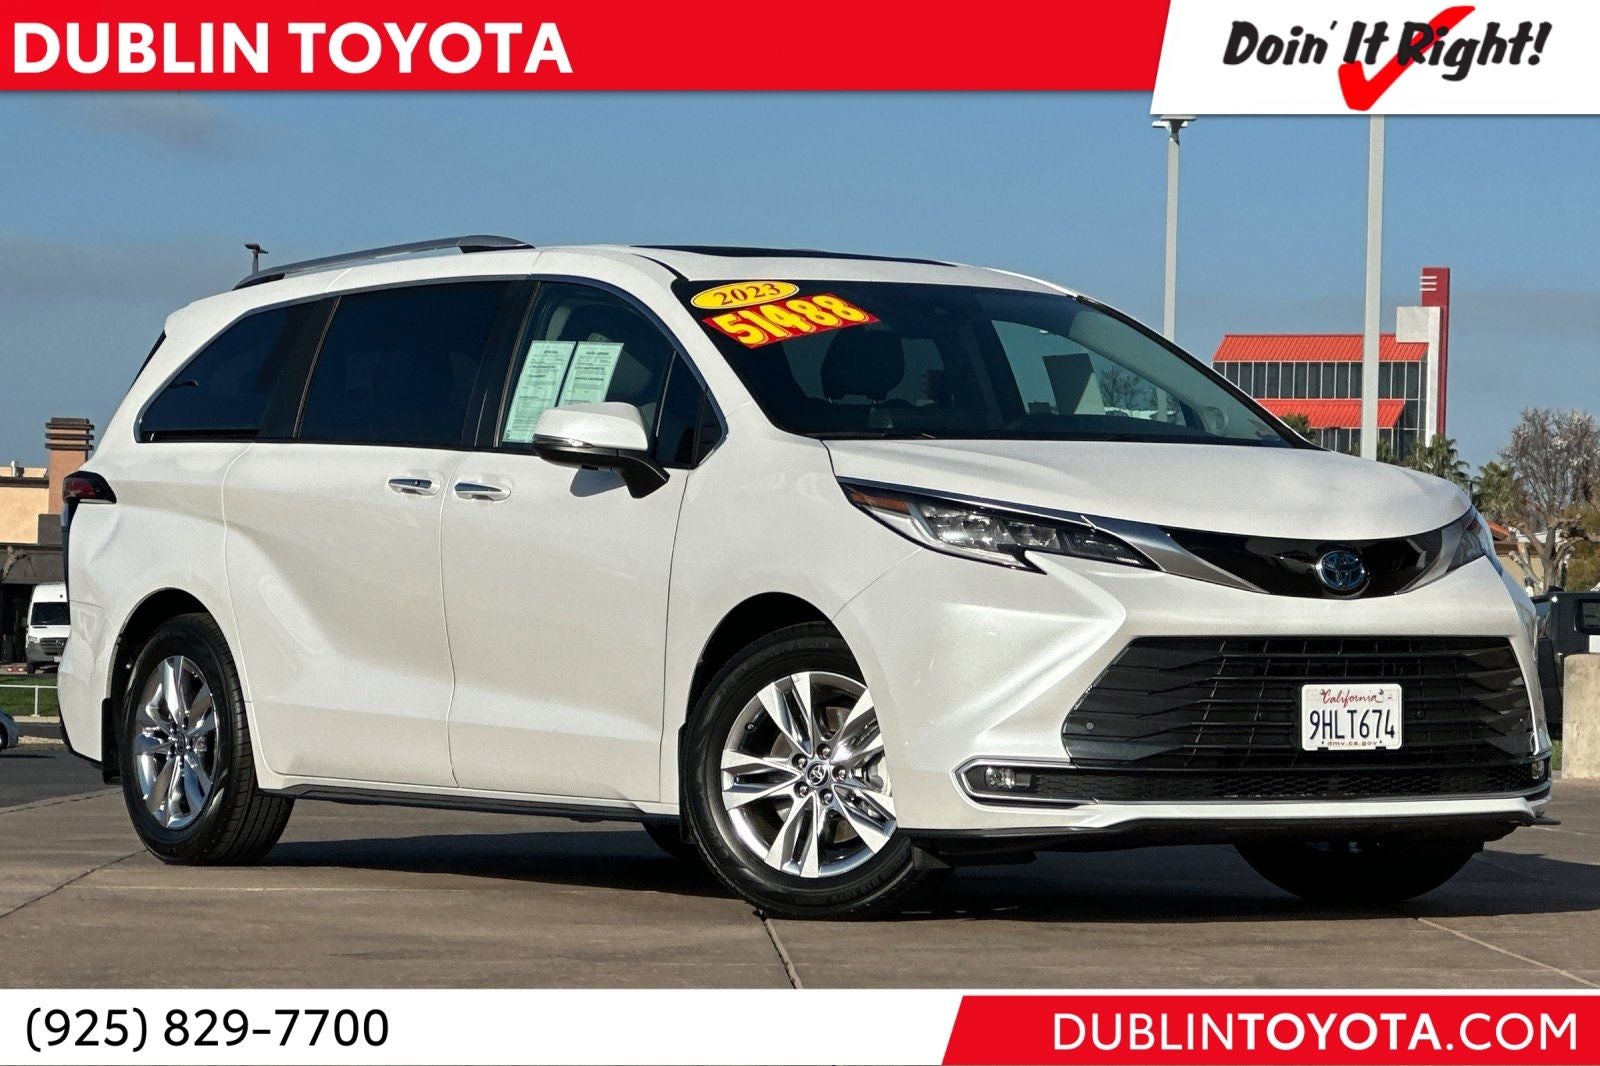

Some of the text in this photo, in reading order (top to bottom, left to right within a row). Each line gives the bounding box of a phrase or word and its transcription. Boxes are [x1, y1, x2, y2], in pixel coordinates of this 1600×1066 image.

[714, 283, 781, 306] 2023
[711, 295, 869, 346] 51488
[1321, 689, 1383, 708] California
[1309, 708, 1395, 740] 9HLT674
